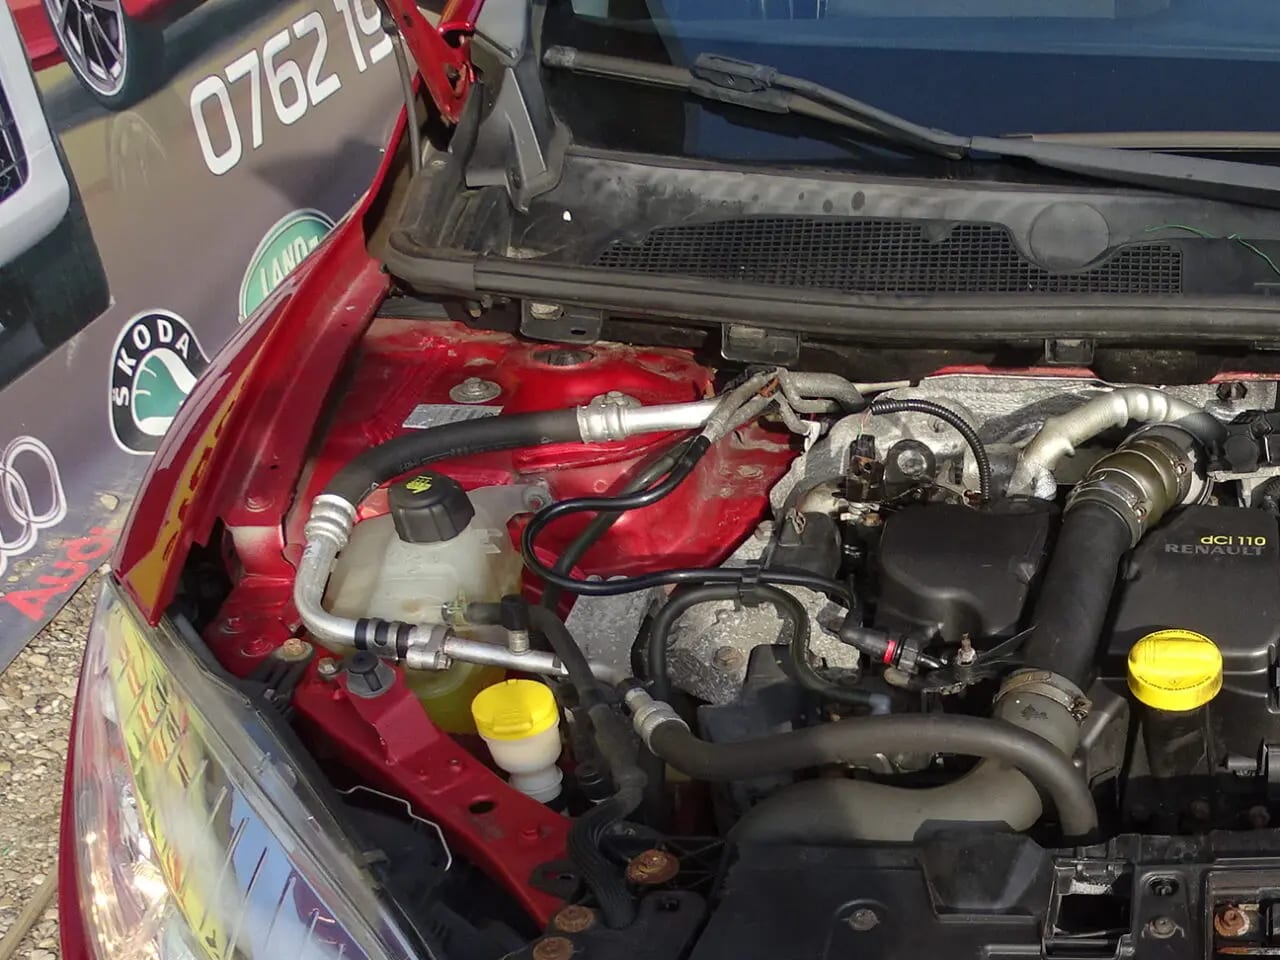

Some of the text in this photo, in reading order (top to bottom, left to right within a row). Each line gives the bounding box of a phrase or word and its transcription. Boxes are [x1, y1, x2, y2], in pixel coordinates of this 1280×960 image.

[190, 11, 342, 176] 0762
[1237, 536, 1267, 546] 110
[1164, 543, 1265, 556] RENAULT
